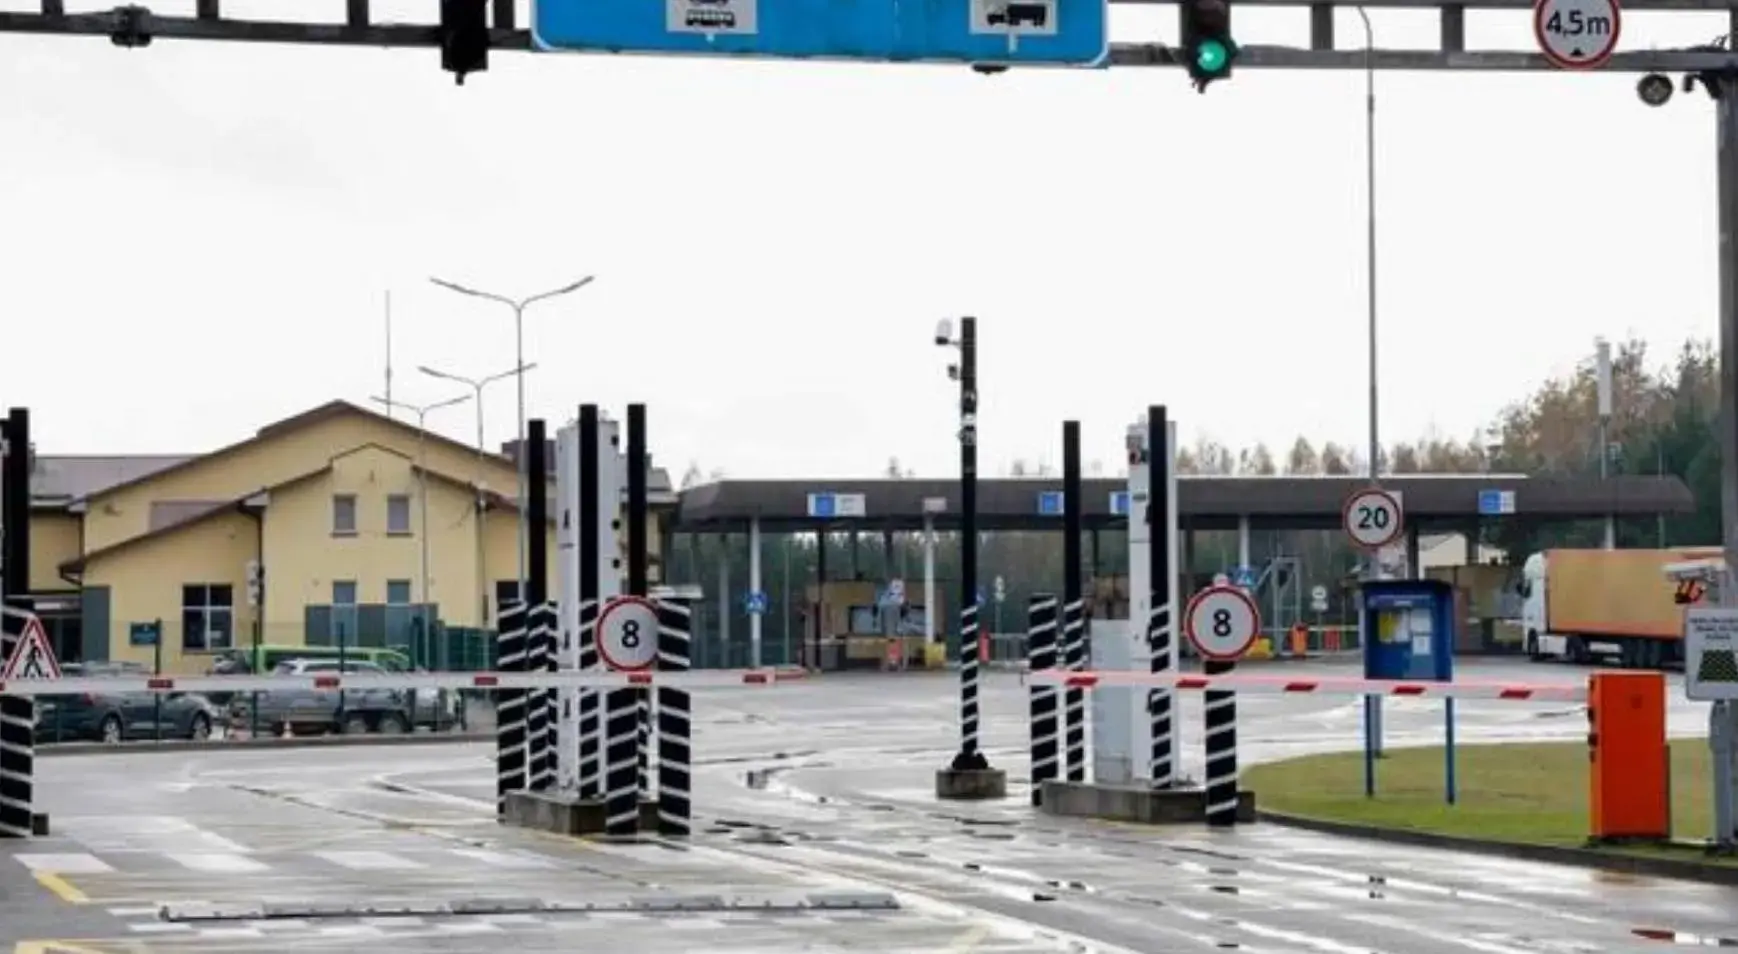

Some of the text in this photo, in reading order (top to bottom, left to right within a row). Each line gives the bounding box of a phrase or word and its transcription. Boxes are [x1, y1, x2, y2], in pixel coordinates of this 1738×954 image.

[1358, 506, 1389, 529] 20
[622, 620, 640, 649] 8
[1213, 608, 1232, 637] 8
